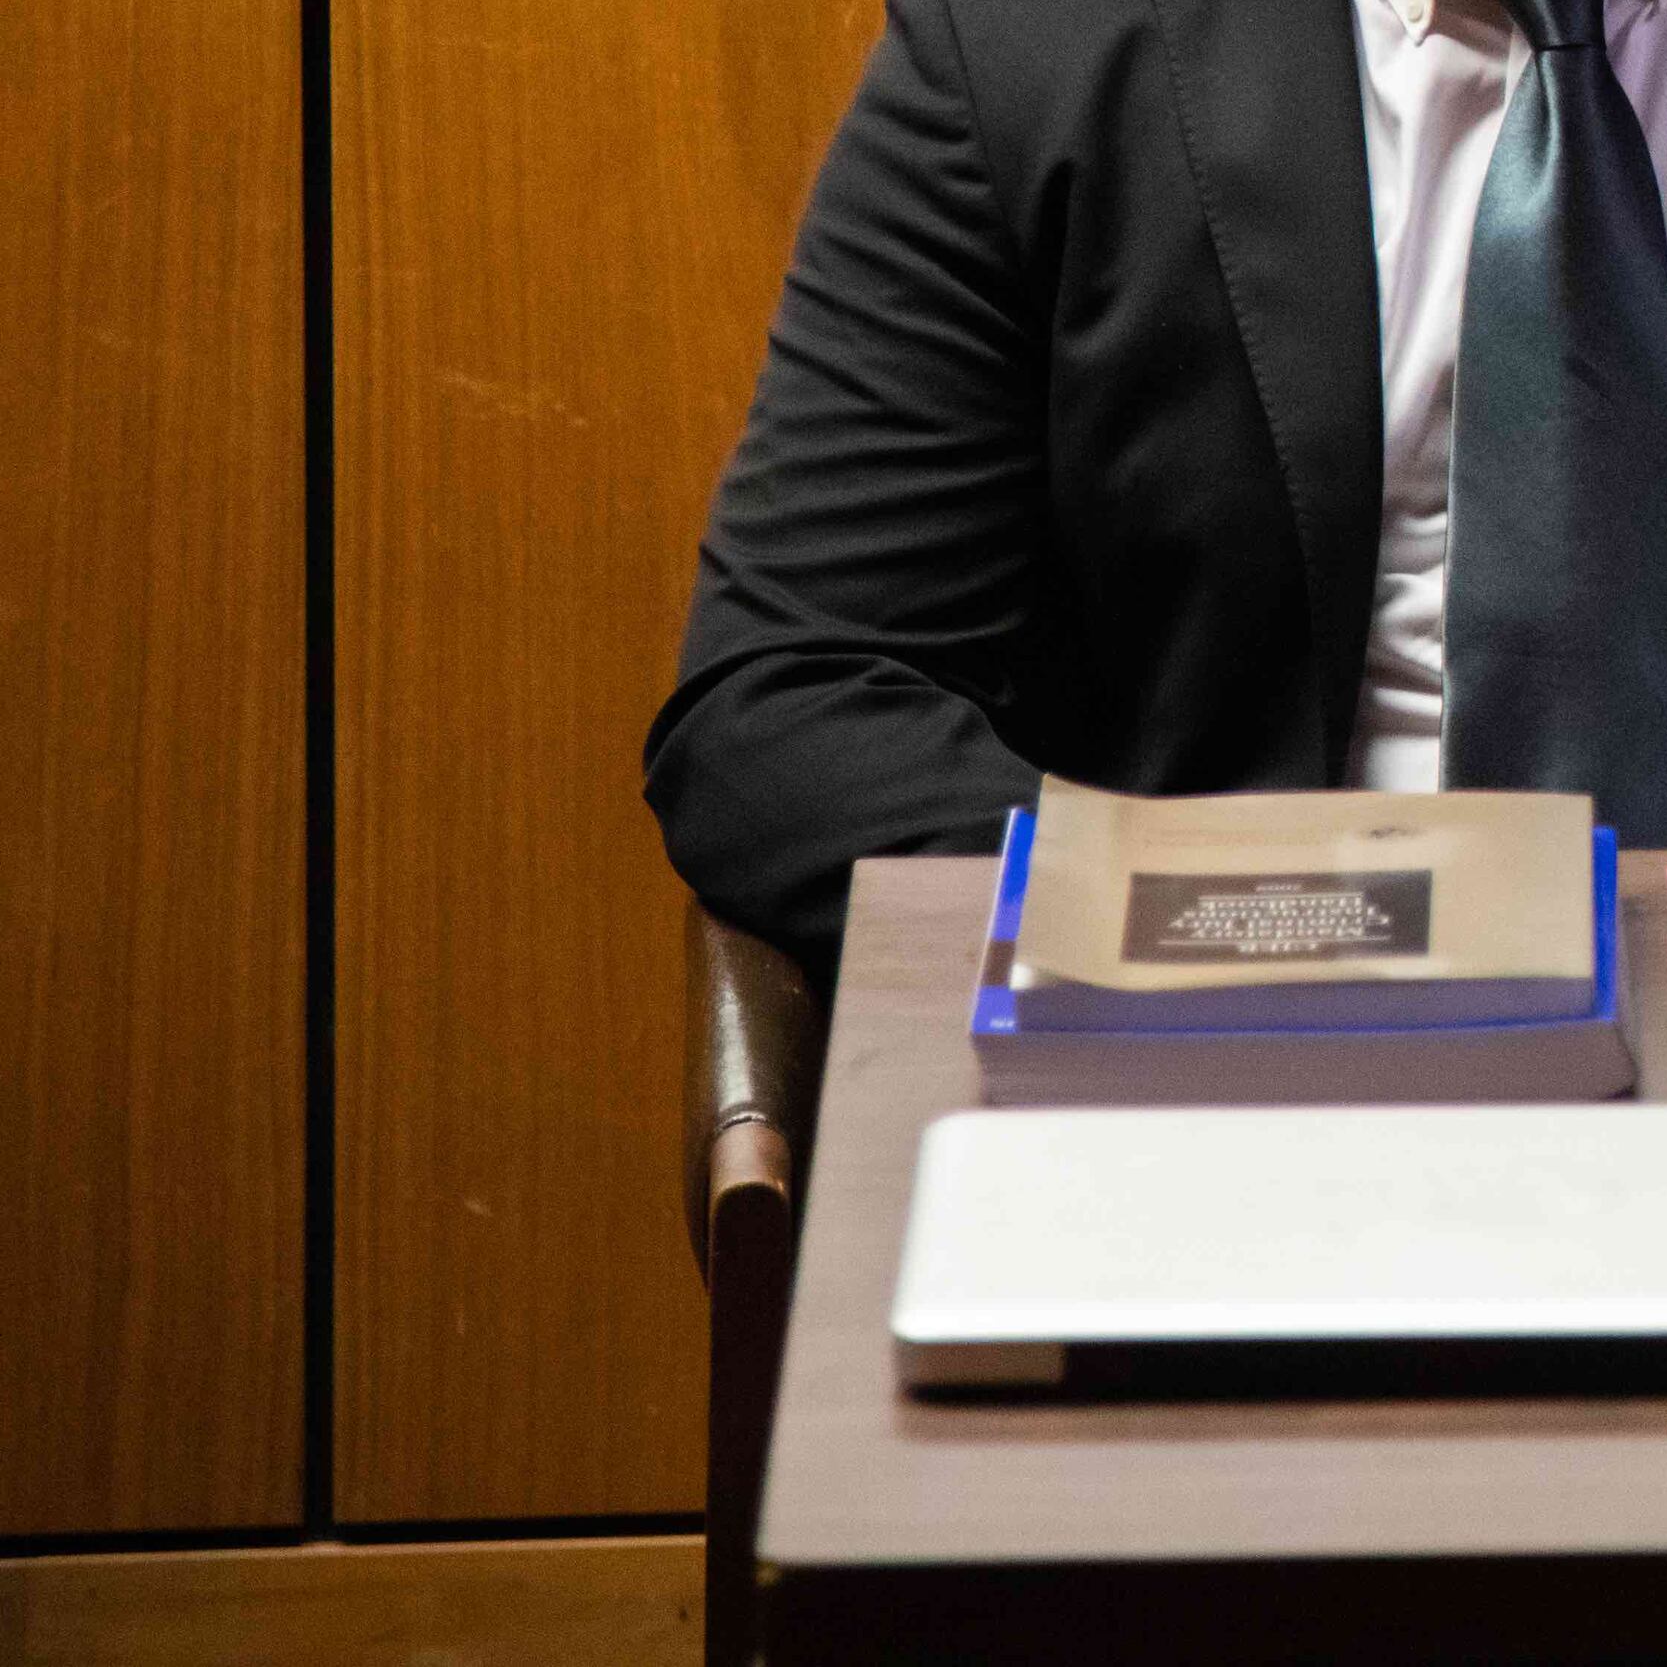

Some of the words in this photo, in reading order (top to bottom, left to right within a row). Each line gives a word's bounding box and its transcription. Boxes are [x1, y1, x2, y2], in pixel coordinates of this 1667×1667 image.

[1198, 896, 1364, 911] Handbook
[1183, 906, 1377, 920] Instructions
[1166, 917, 1236, 931] Jury
[1248, 915, 1390, 930] Criminal
[1190, 926, 1365, 940] Mandatory
